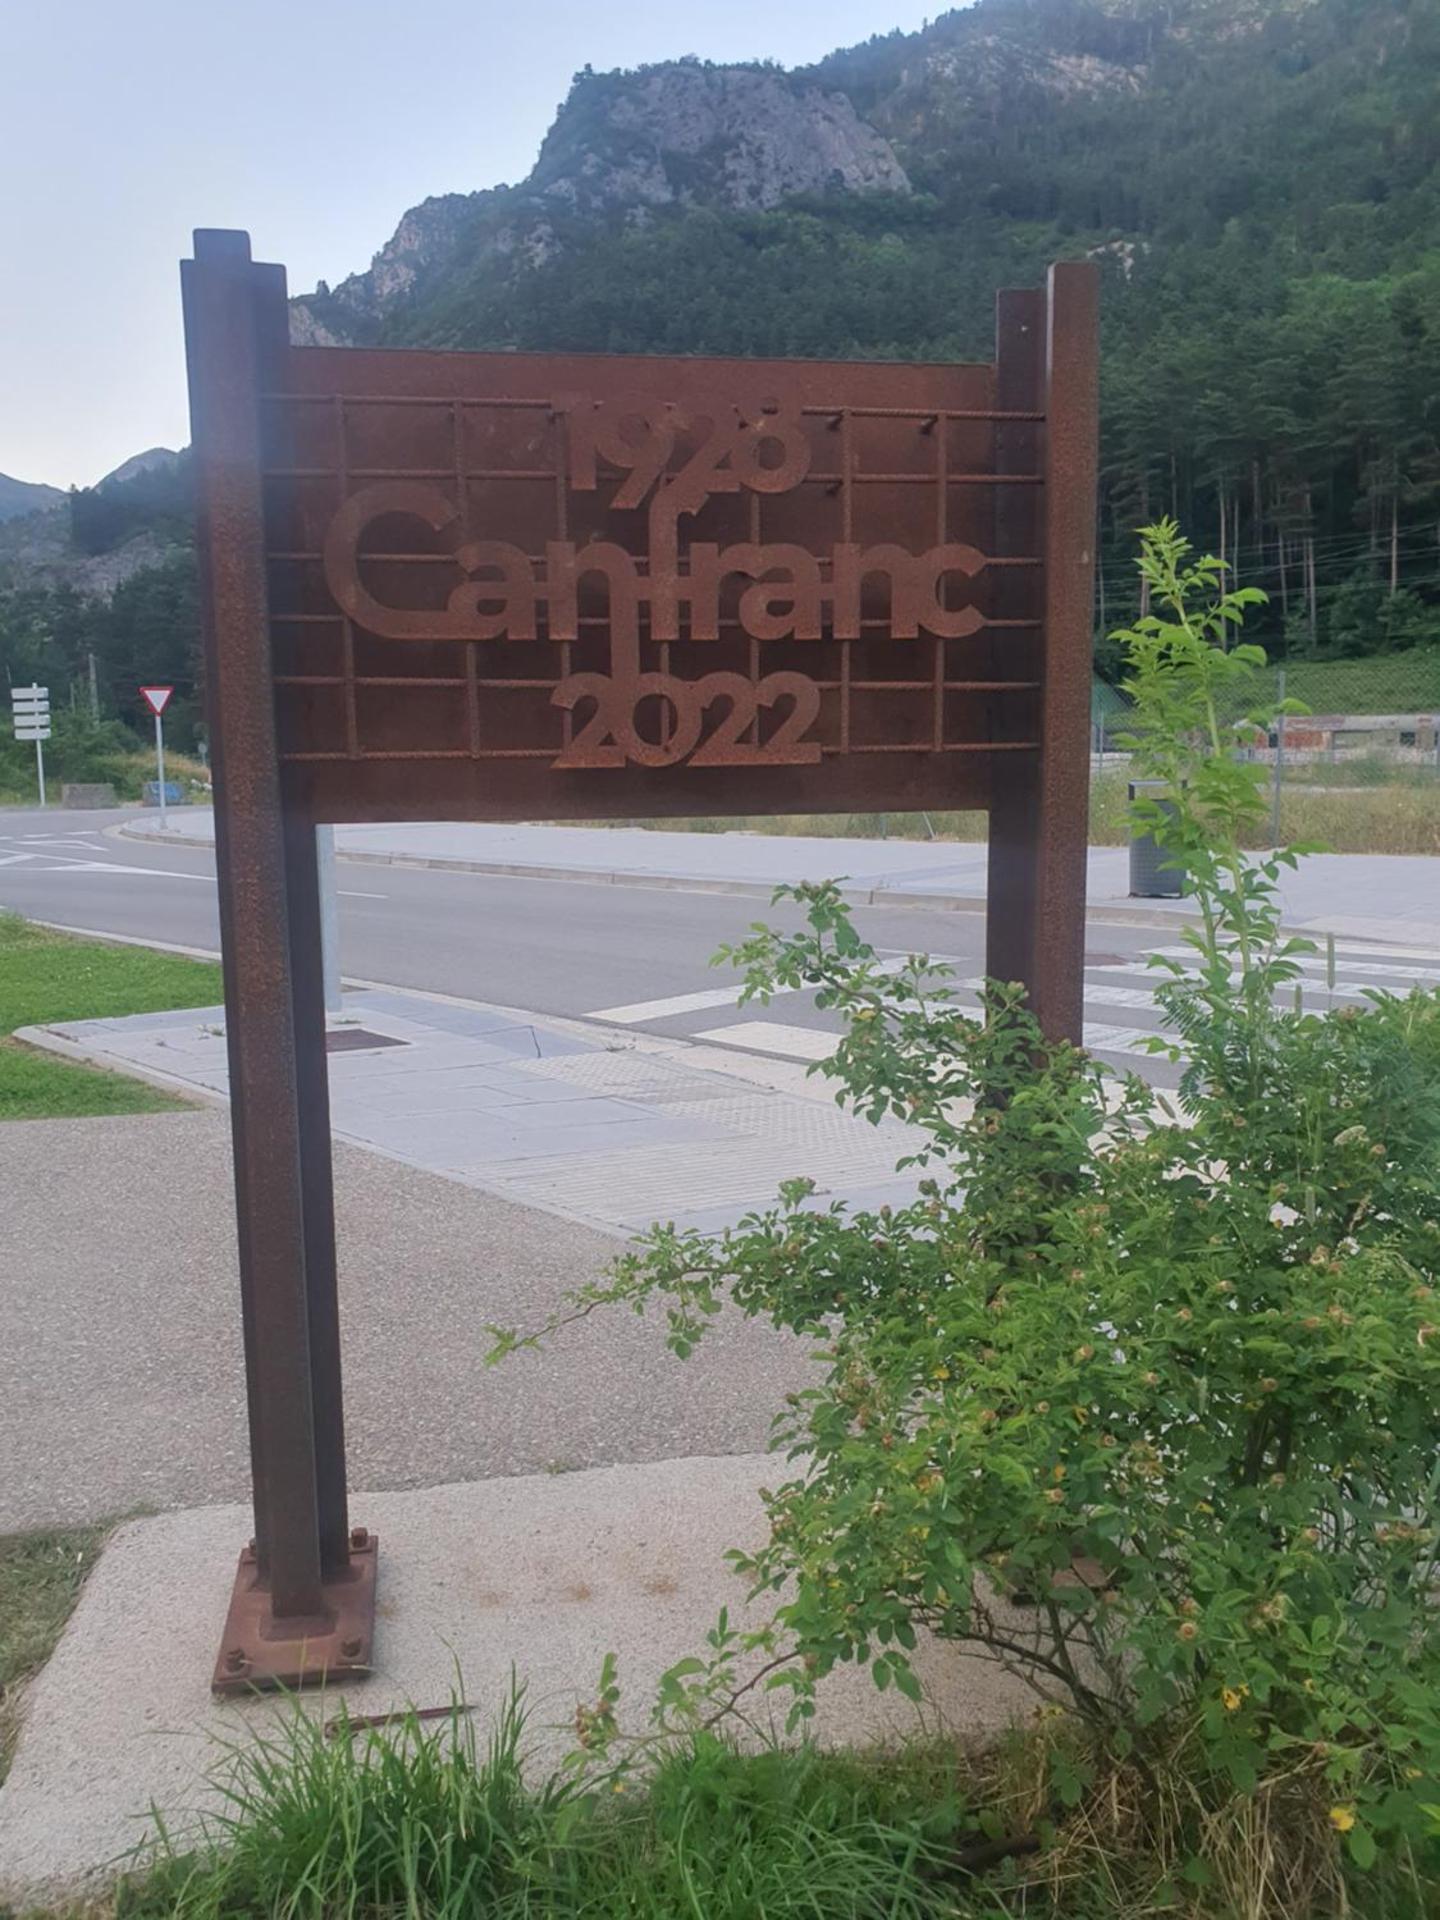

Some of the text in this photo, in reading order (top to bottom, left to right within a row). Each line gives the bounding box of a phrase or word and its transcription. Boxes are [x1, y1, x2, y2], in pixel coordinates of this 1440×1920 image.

[552, 391, 812, 509] 1928
[324, 482, 989, 674] Canfranc
[549, 671, 822, 769] 2022
